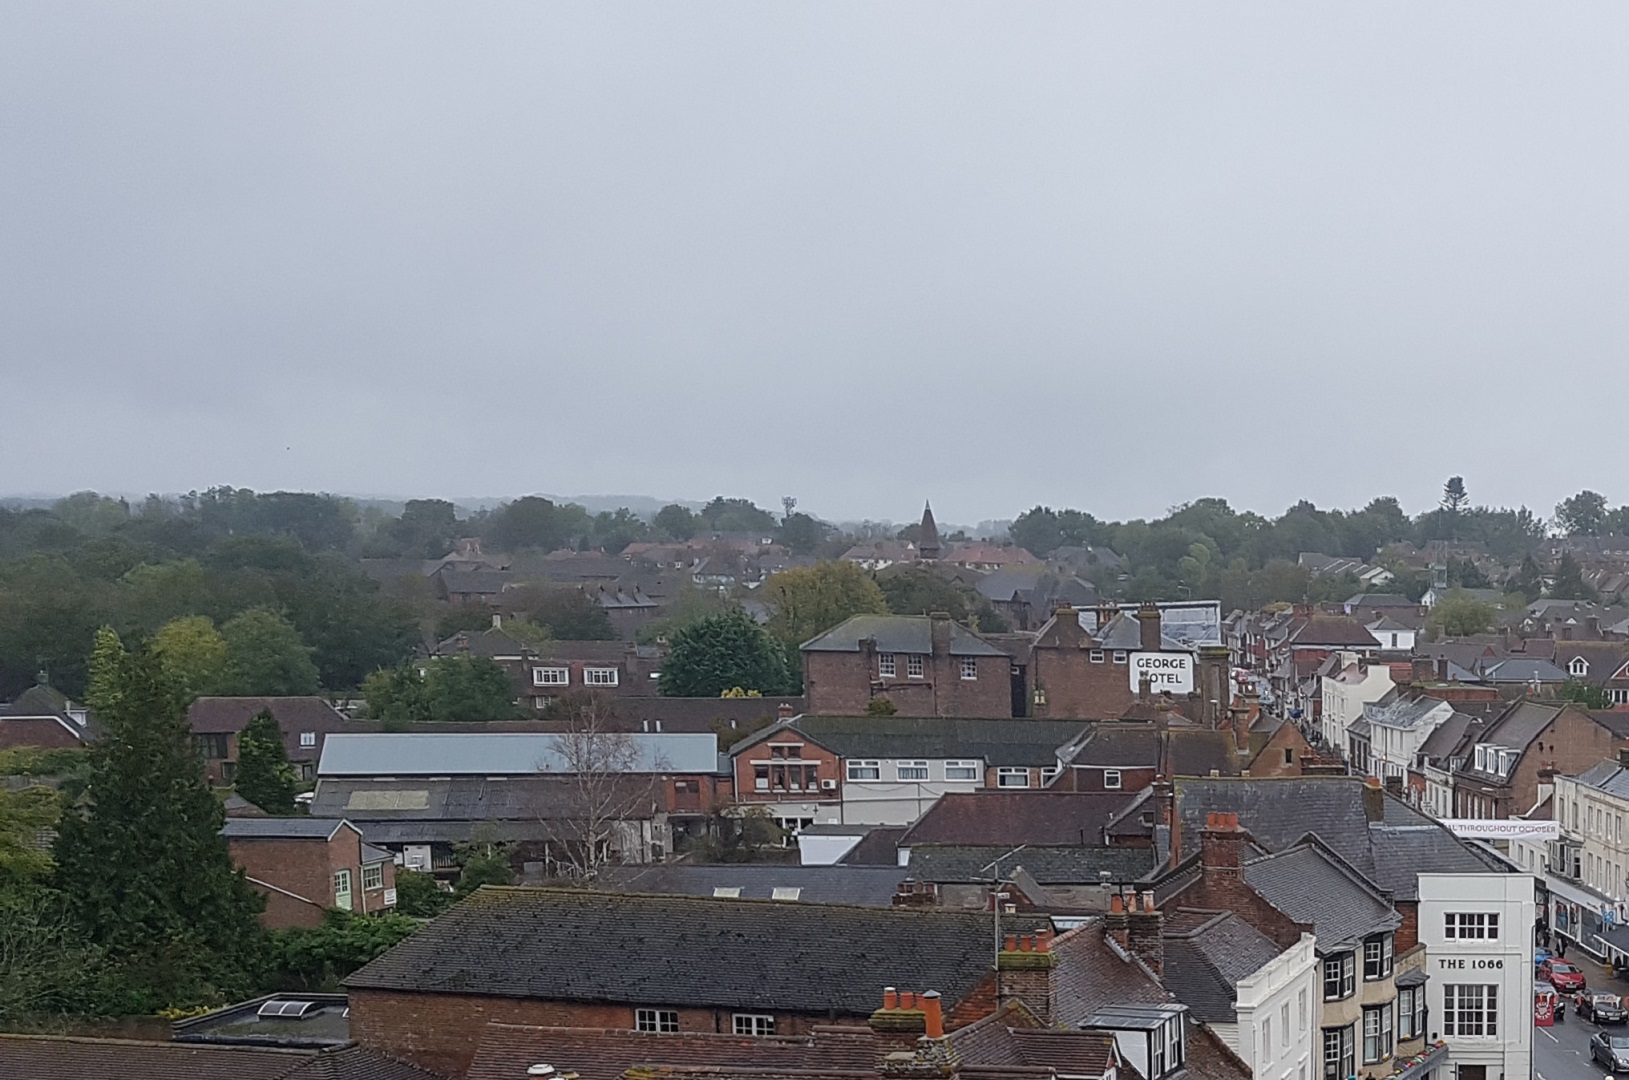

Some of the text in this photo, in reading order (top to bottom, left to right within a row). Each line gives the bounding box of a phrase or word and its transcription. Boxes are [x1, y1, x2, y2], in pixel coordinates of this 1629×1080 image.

[1136, 658, 1186, 669] GEORGE
[1149, 673, 1183, 684] OTEL
[1459, 824, 1517, 833] THROUGHOUT
[1518, 824, 1556, 833] OCTOBER
[1438, 959, 1504, 969] THE 1066
